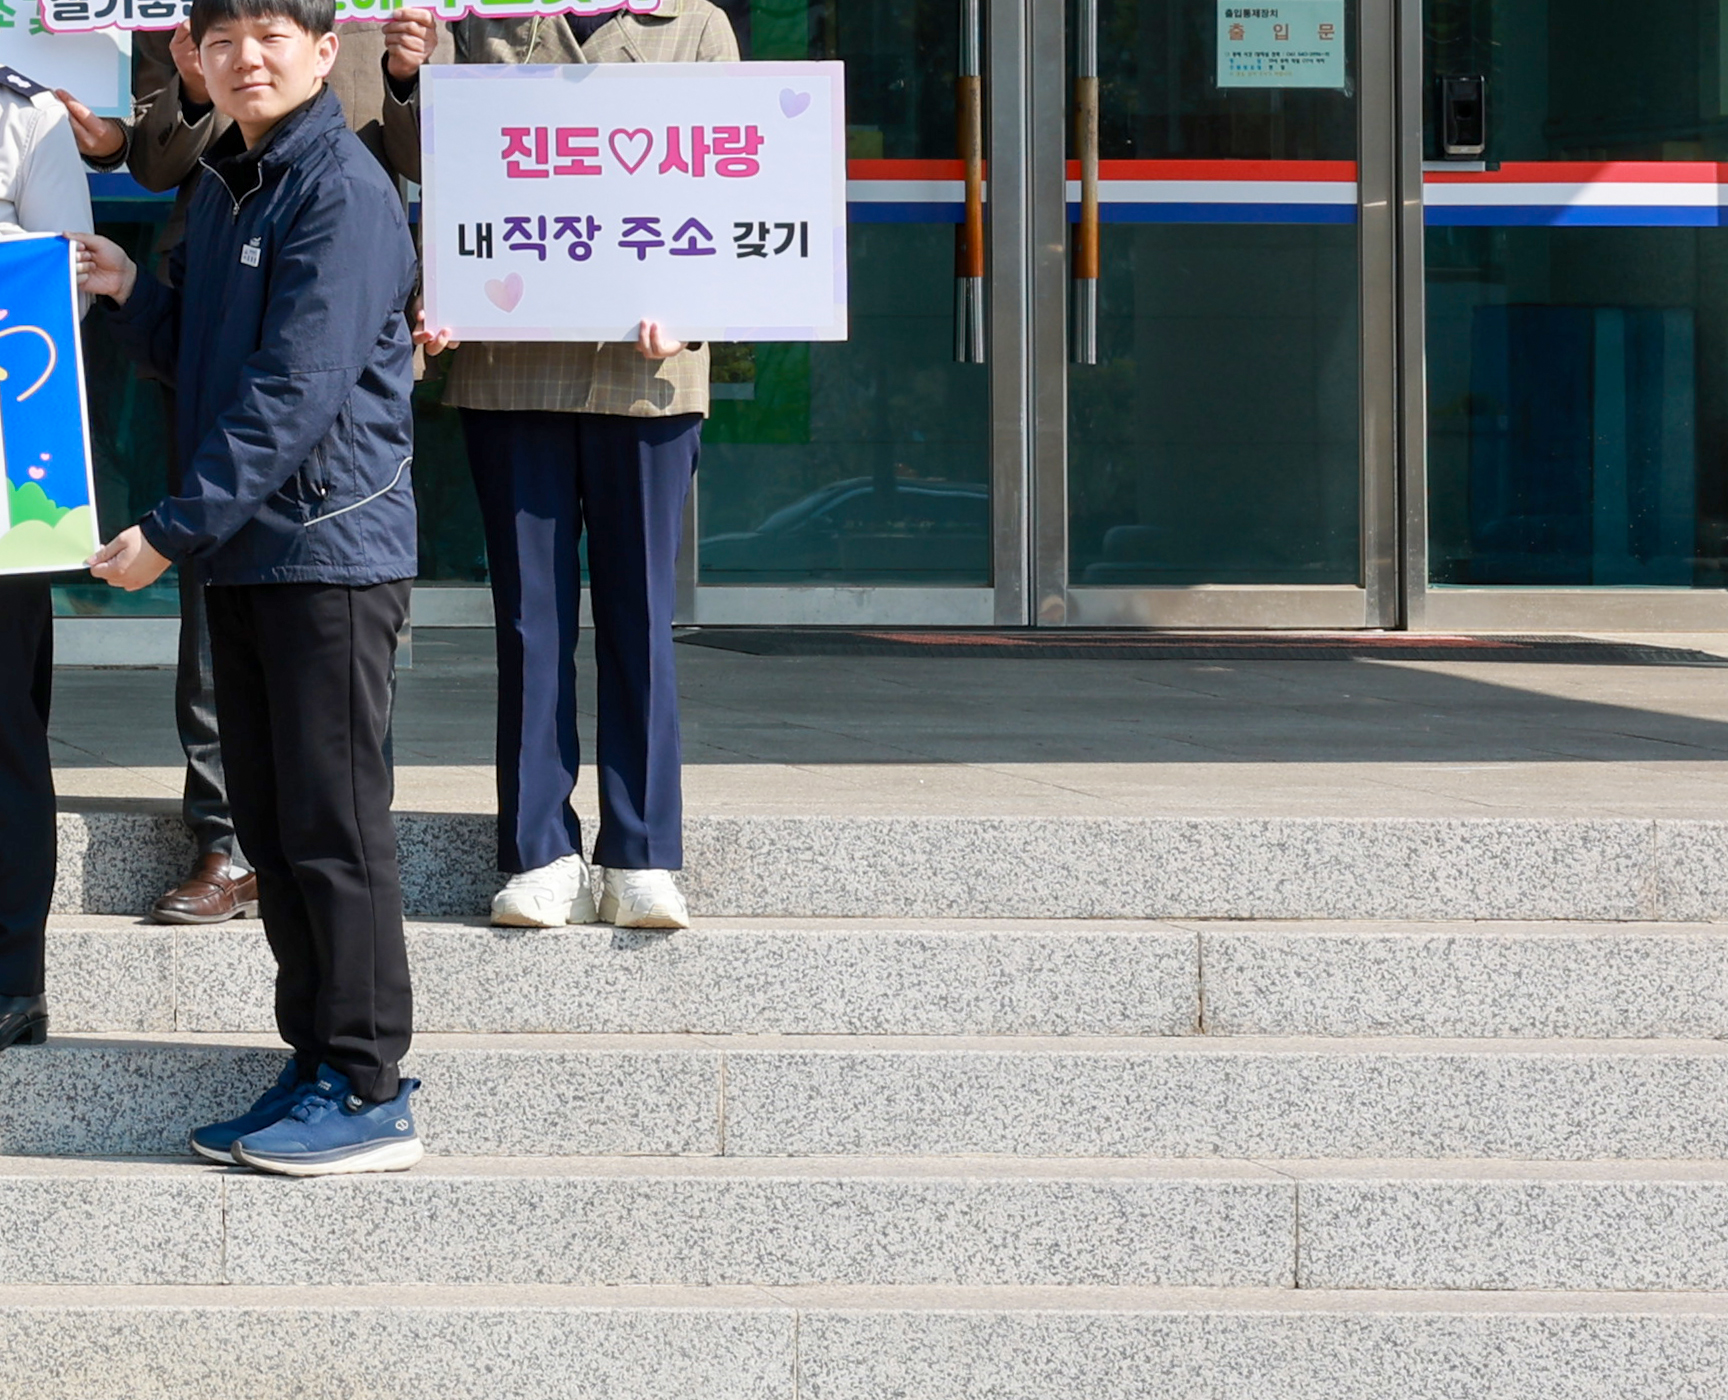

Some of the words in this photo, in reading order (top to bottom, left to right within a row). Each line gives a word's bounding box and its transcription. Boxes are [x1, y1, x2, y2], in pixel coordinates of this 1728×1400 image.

[457, 222, 494, 259] 내
[501, 215, 603, 262] 직장
[617, 217, 718, 262] 주소
[732, 221, 809, 259] 갖기
